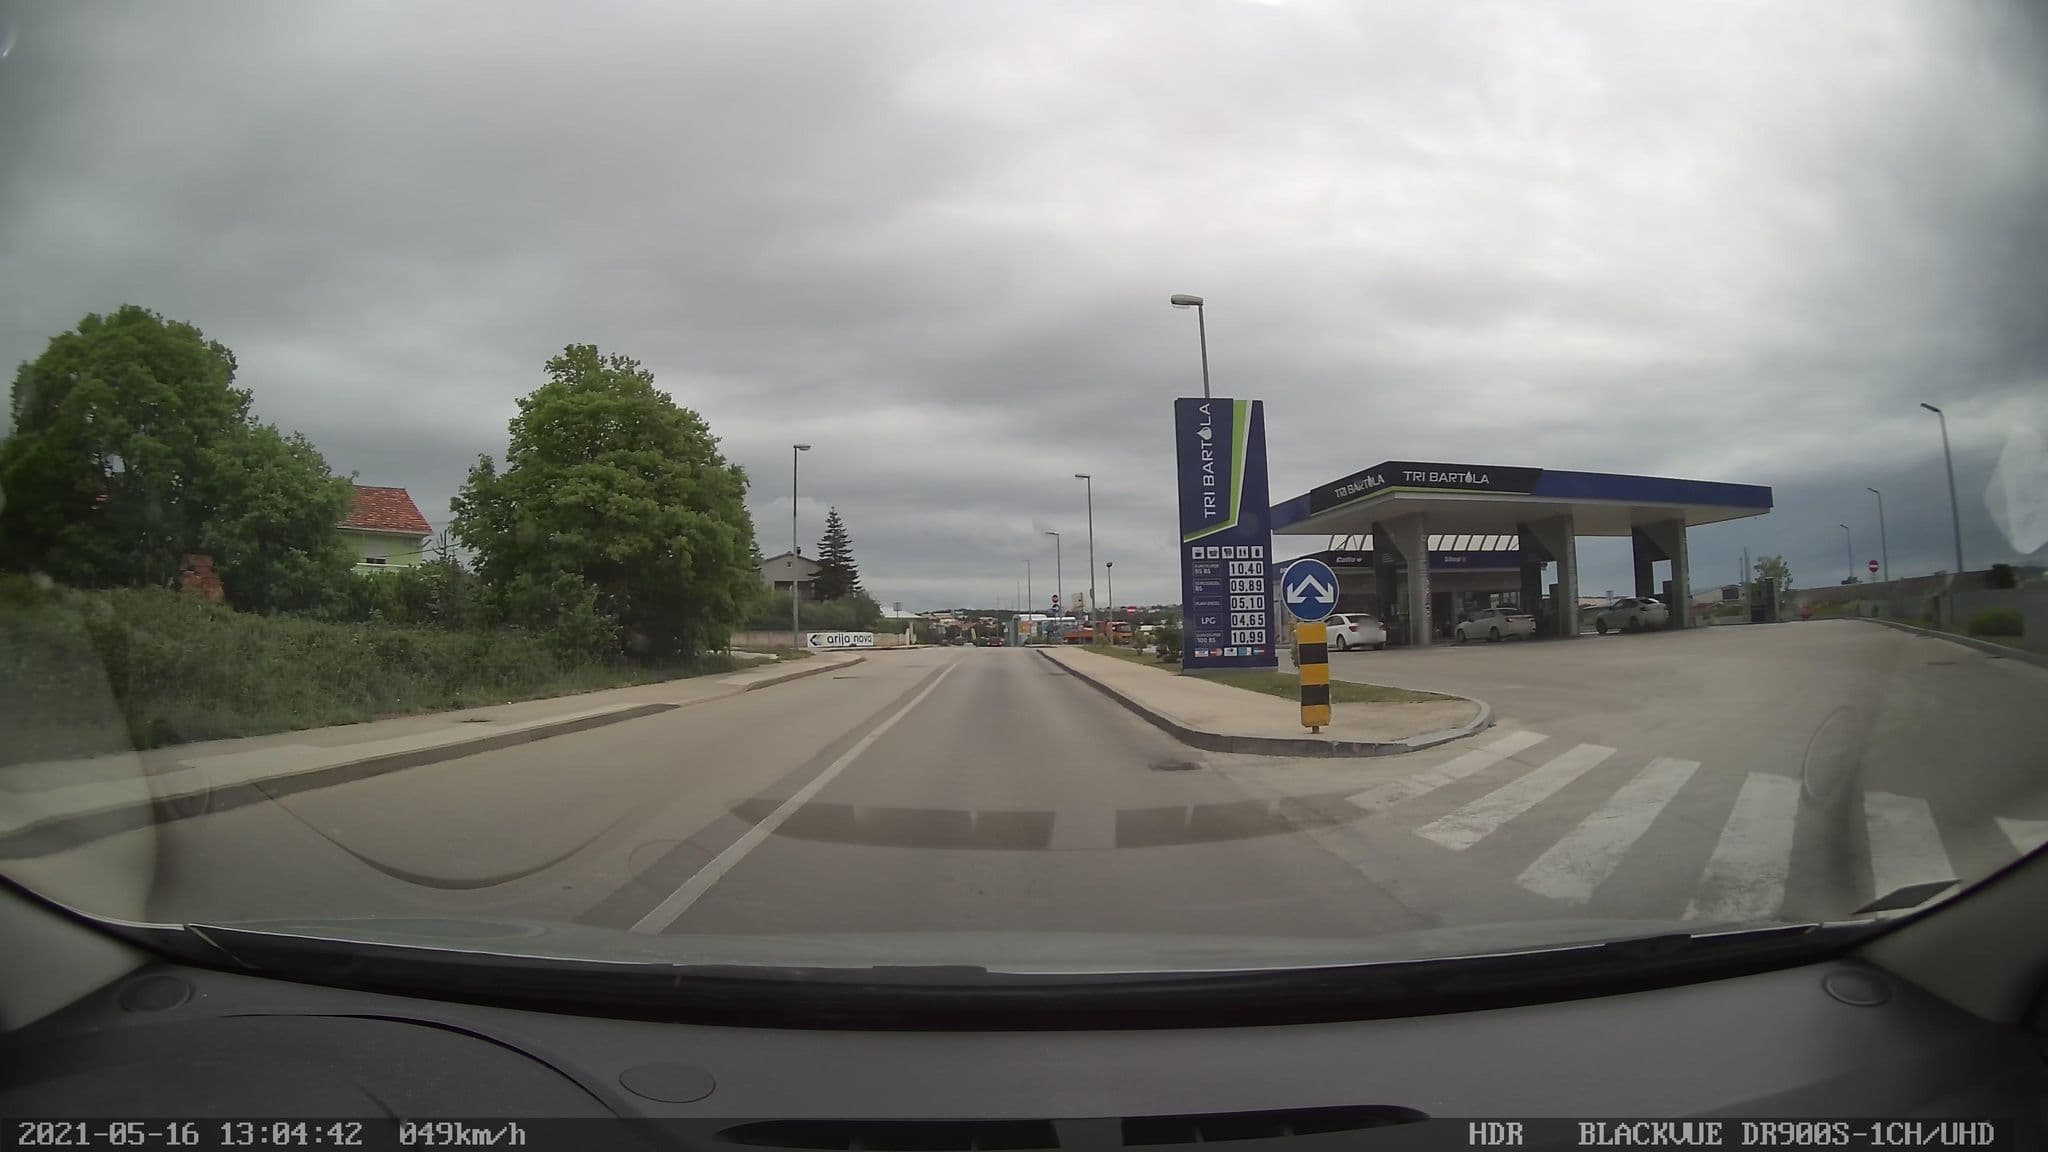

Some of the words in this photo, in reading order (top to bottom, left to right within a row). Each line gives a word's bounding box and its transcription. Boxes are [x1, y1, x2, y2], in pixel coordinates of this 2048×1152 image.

[1403, 471, 1425, 482] TRI
[1204, 492, 1216, 518] TRI
[1231, 562, 1262, 575] 10.40
[1231, 579, 1262, 592] 09.89
[1232, 597, 1263, 609] 05.10
[1201, 616, 1216, 624] LPG
[1232, 614, 1264, 627] 04.65
[1232, 631, 1264, 644] 10.99
